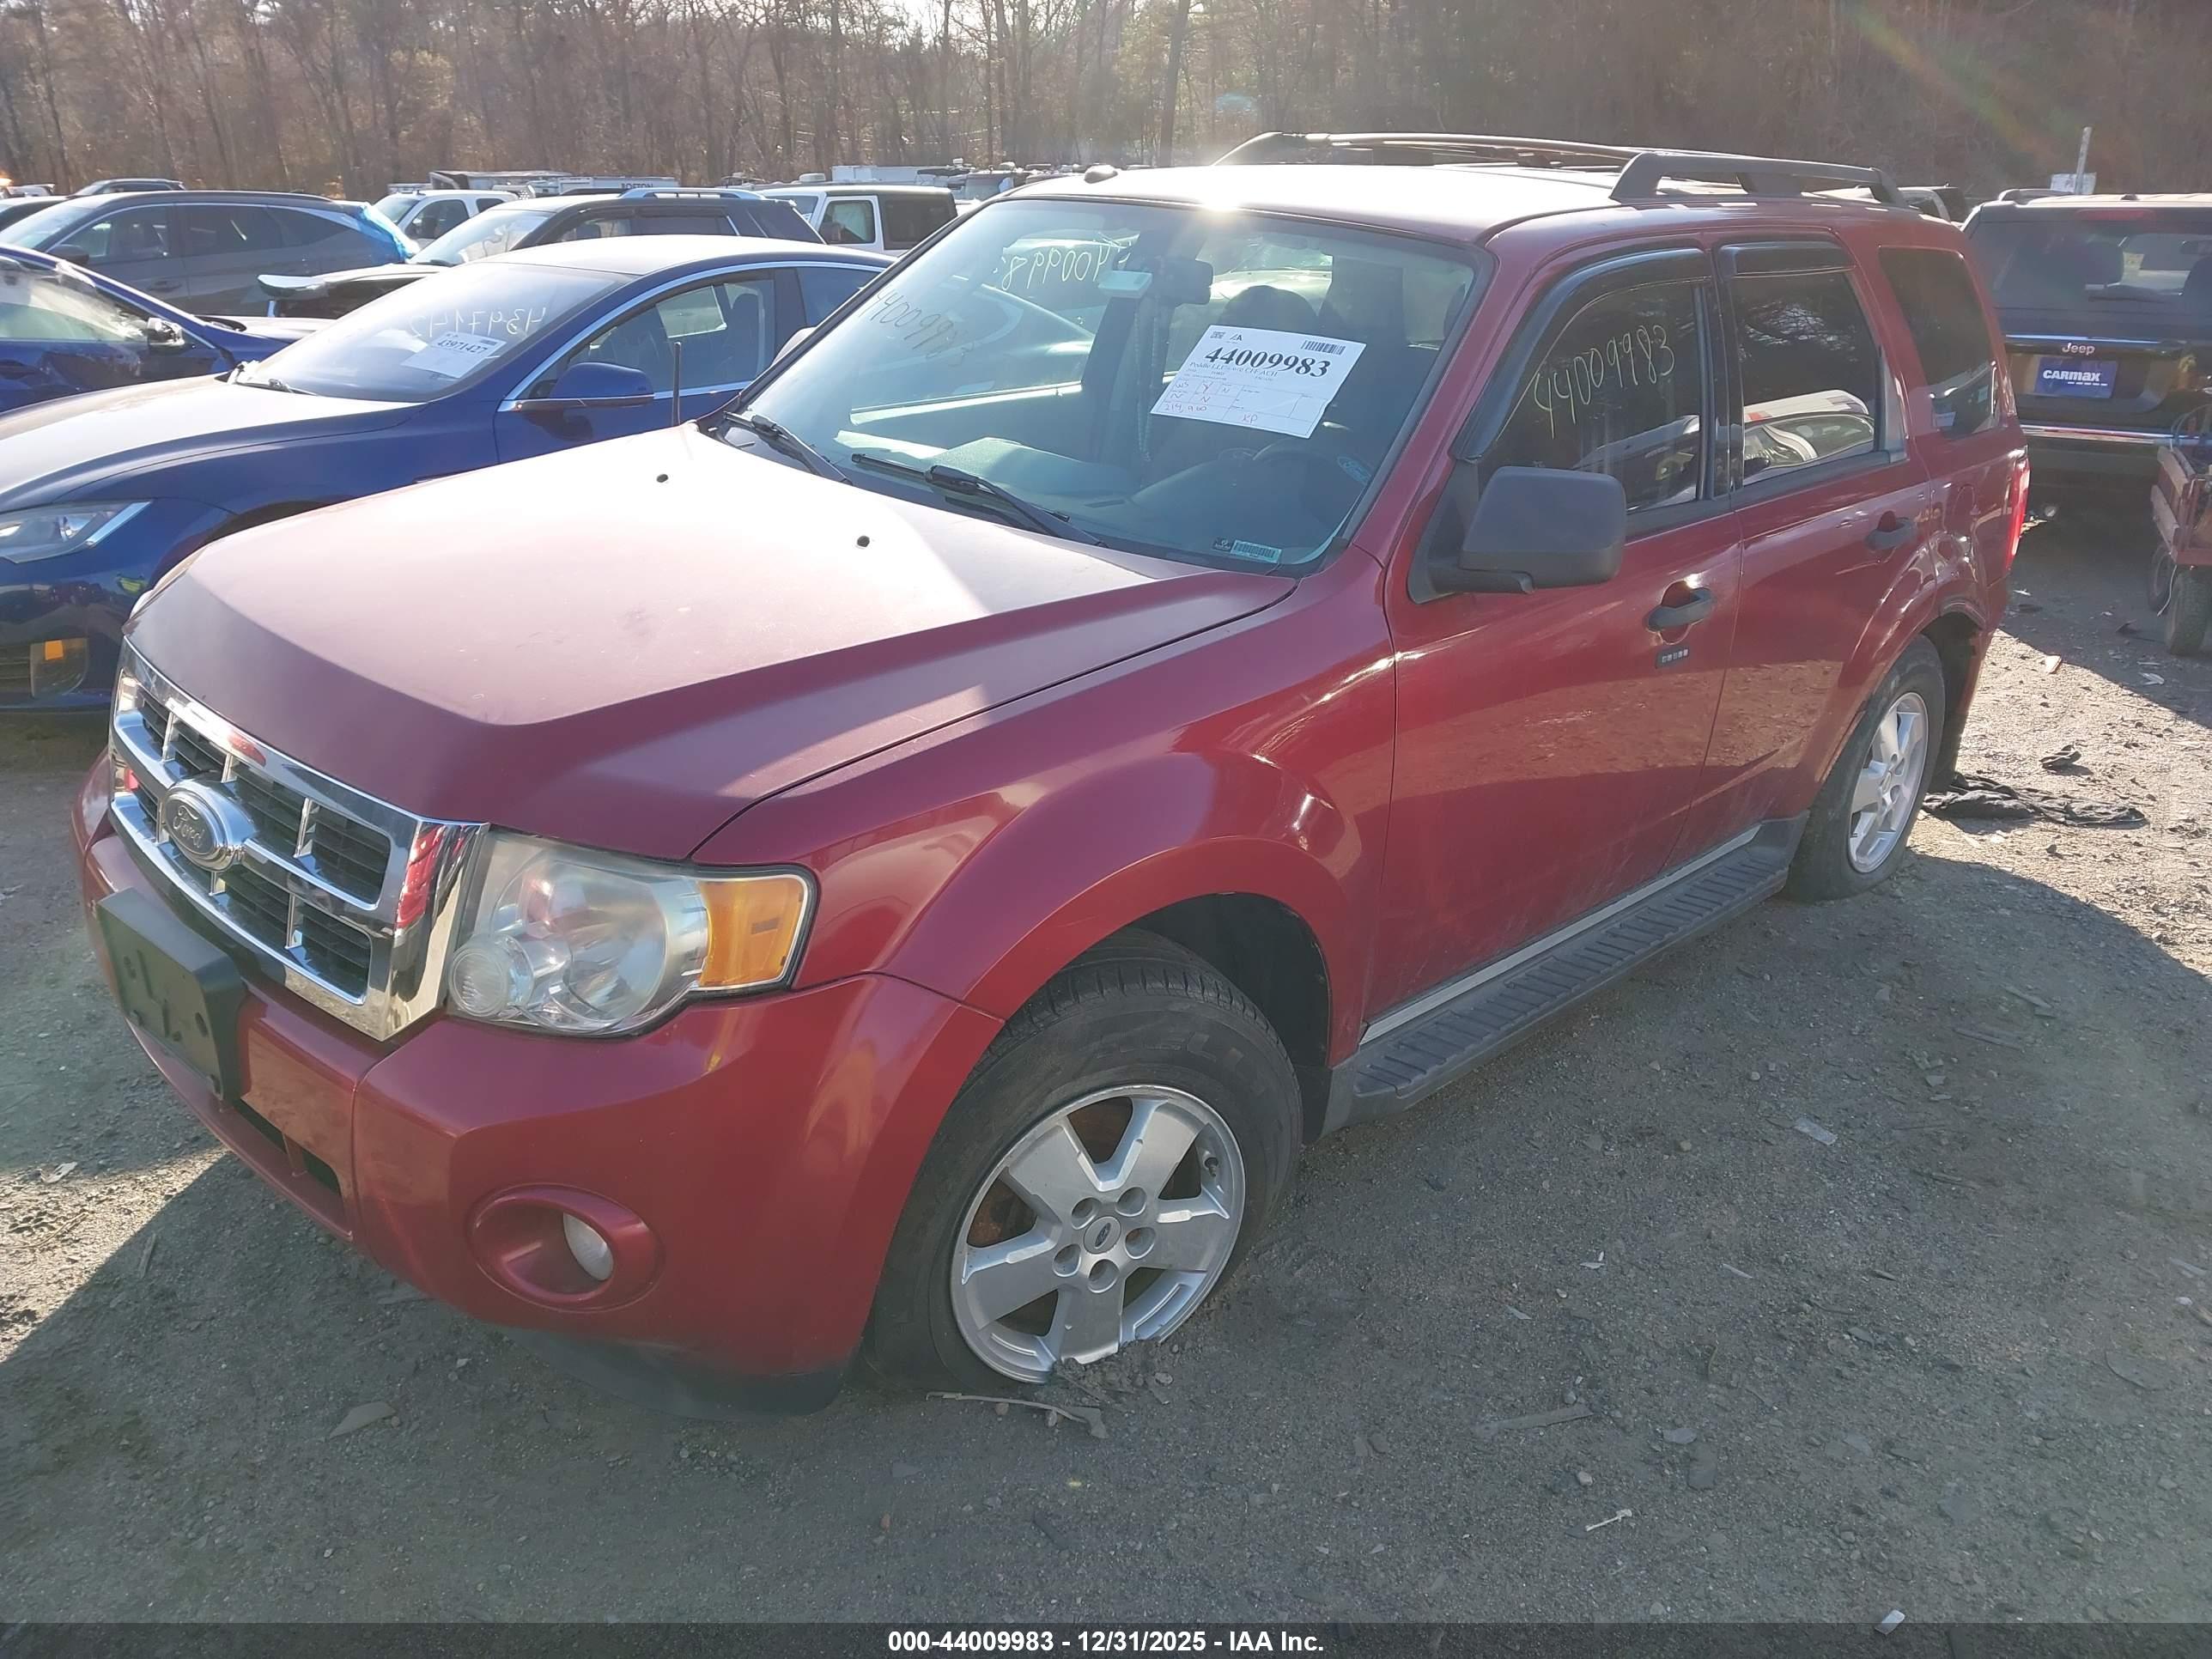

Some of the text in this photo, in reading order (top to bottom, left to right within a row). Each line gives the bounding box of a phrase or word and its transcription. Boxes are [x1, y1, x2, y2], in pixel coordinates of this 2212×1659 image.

[1205, 346, 1331, 378] 44009983
[2062, 343, 2096, 355] Jeep
[1534, 325, 1675, 440] 44009983
[173, 805, 205, 848] Ford
